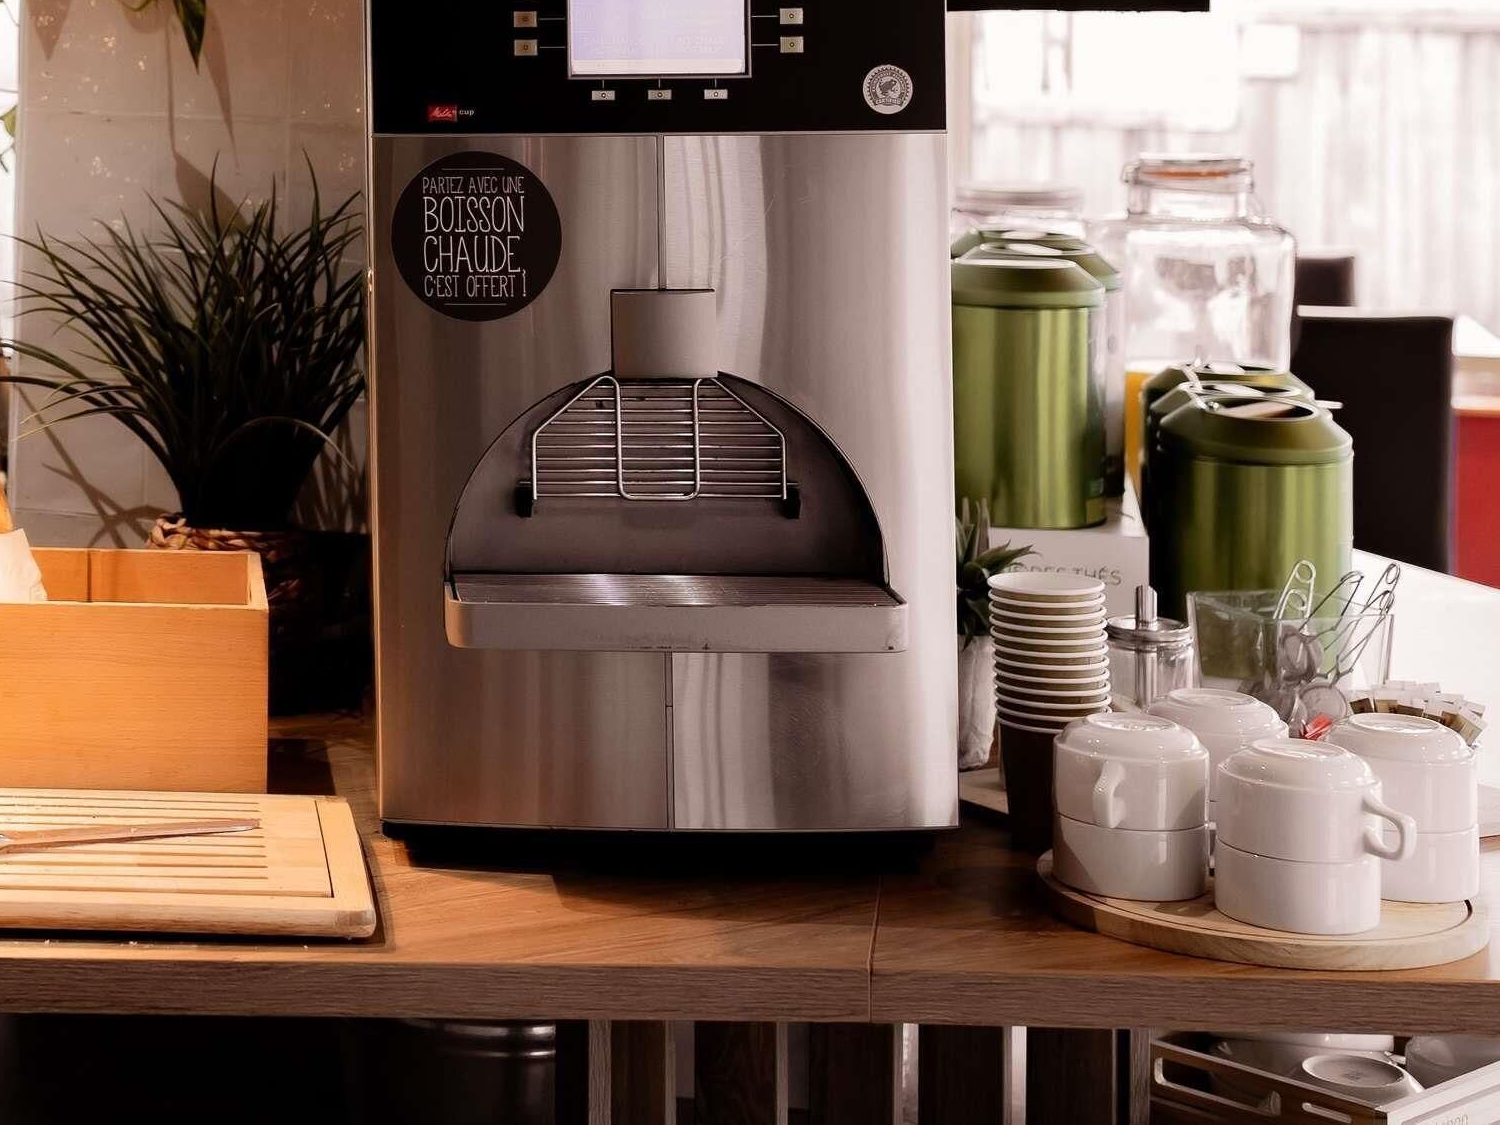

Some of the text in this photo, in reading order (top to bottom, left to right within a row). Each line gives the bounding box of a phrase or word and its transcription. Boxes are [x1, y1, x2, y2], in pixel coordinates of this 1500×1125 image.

[422, 176, 525, 194] PARTEZ AVEC UNE
[422, 195, 525, 233] BOISSON
[423, 235, 527, 275] CHAUDE,
[424, 275, 460, 298] C'EST
[466, 275, 516, 298] OFFERT
